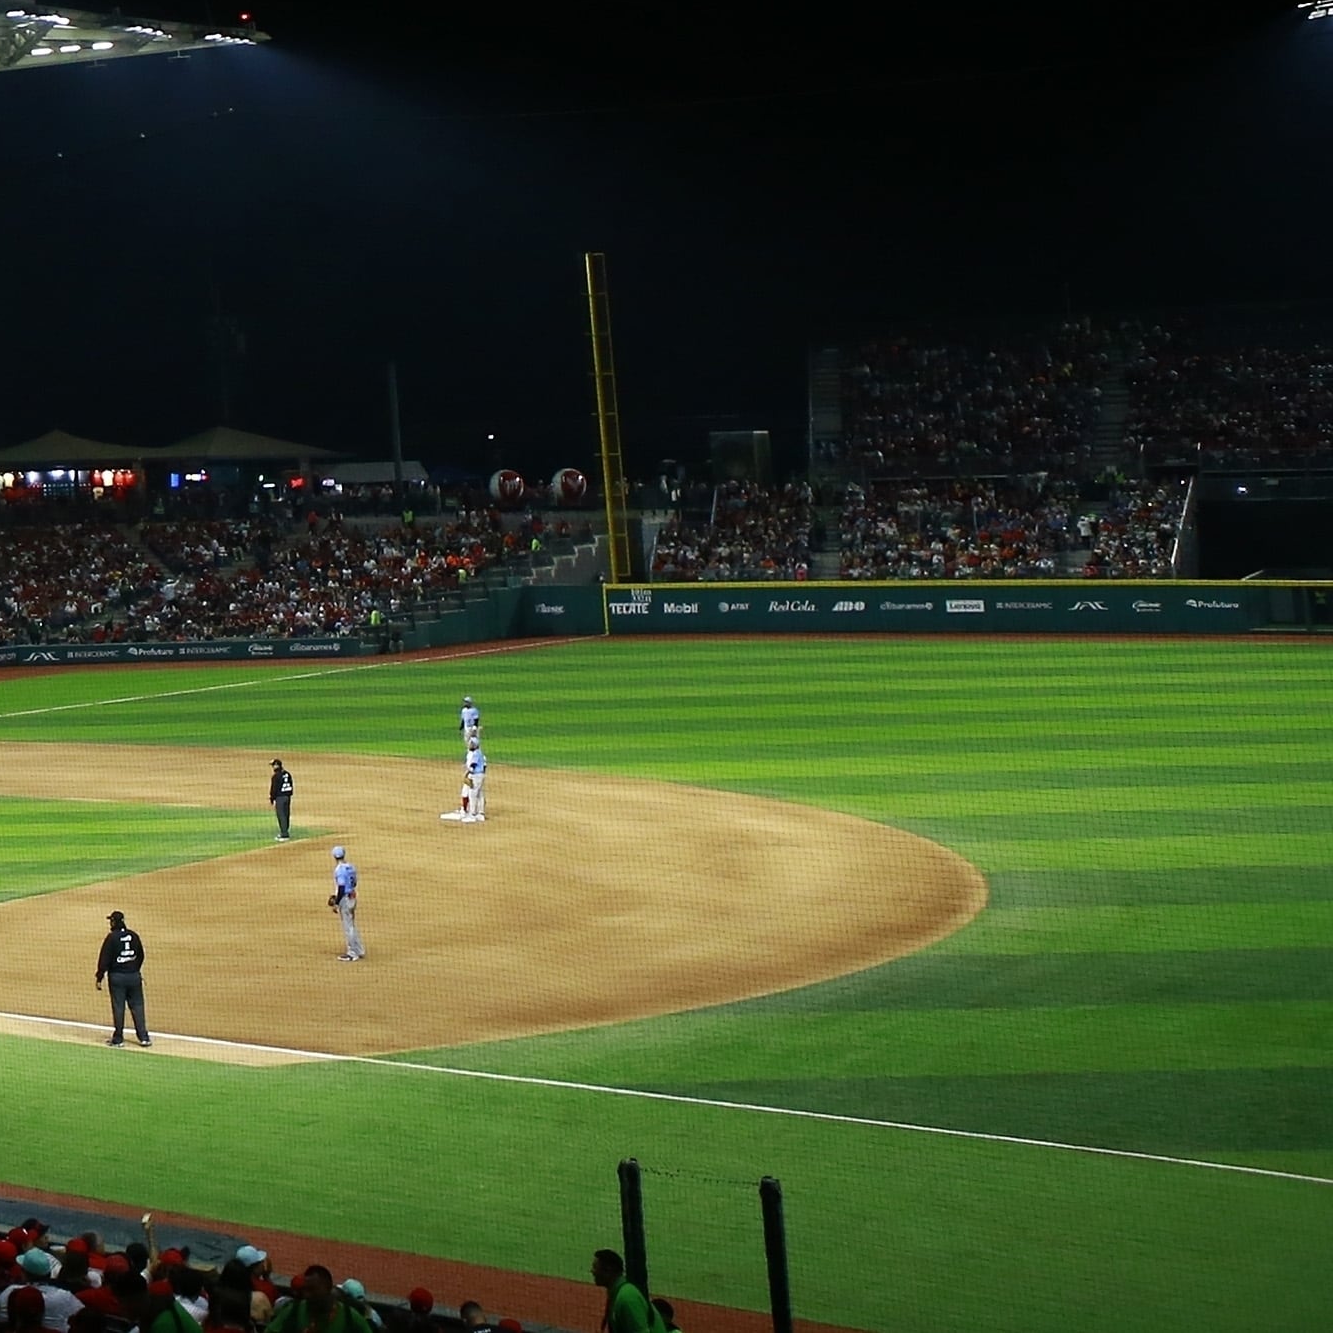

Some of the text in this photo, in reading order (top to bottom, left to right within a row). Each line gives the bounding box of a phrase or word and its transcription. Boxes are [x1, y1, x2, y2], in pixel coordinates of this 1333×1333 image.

[608, 602, 650, 615] TECATE
[663, 602, 700, 614] Mobil
[767, 600, 817, 613] Red Cola
[831, 601, 866, 612] ADO
[1197, 600, 1240, 610] Profuturo
[138, 647, 174, 657] Profuturo
